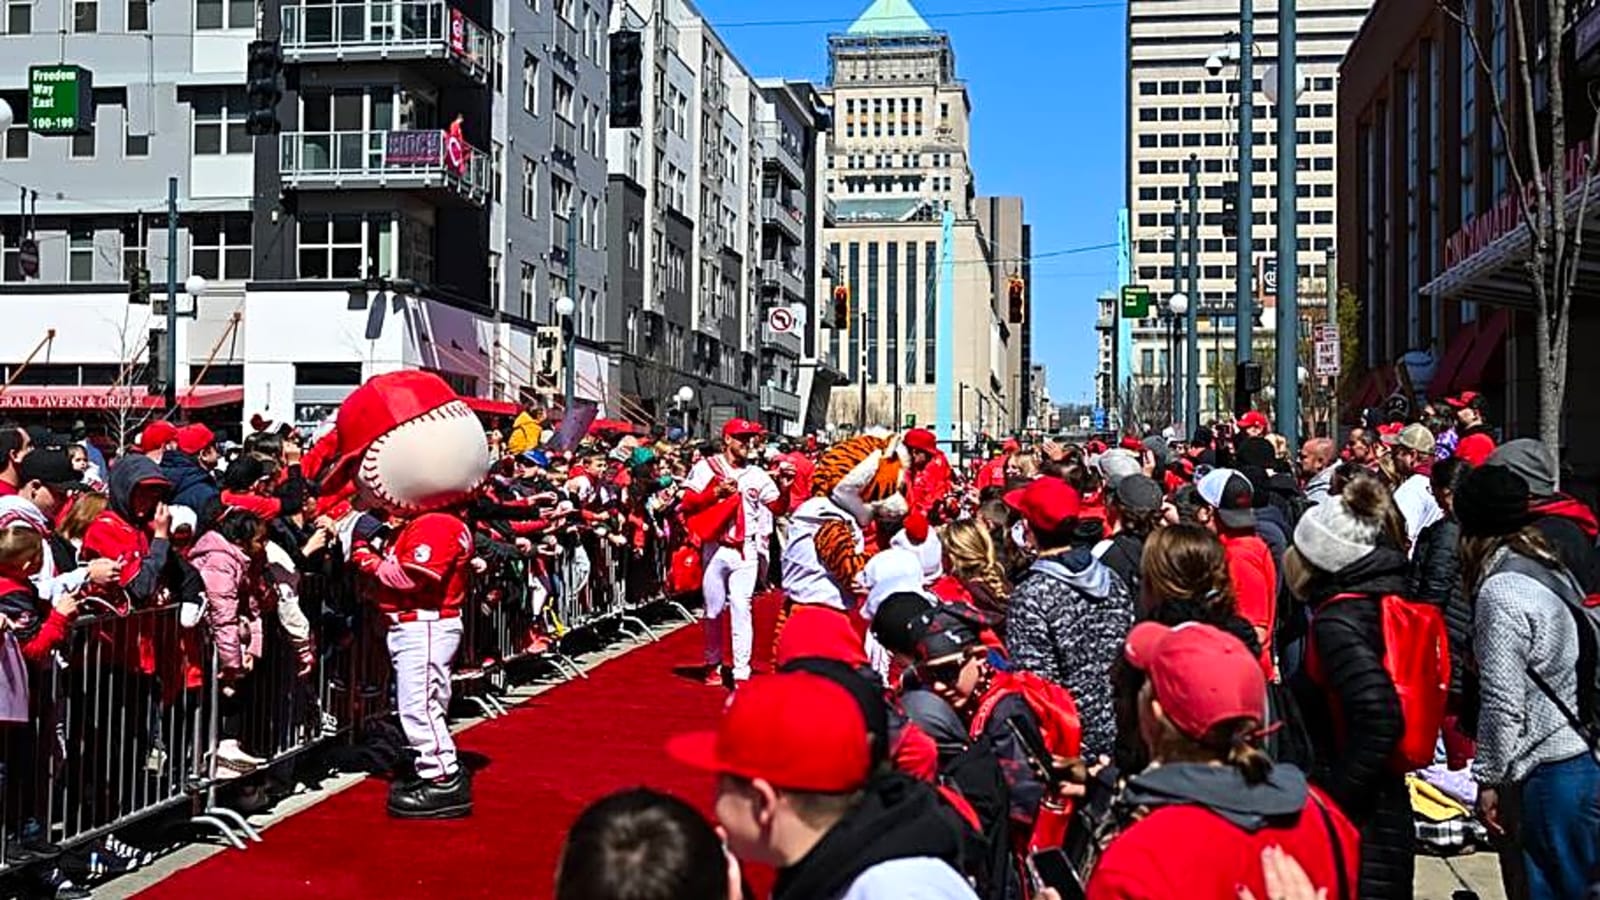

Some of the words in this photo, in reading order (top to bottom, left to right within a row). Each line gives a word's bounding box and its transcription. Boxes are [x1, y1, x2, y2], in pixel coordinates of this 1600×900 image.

[33, 70, 76, 81] Freedom
[33, 84, 54, 96] Way
[33, 97, 54, 108] East
[33, 117, 73, 129] 100-199
[1320, 343, 1334, 353] ANY
[36, 395, 84, 408] TAVERN
[85, 396, 96, 408] &
